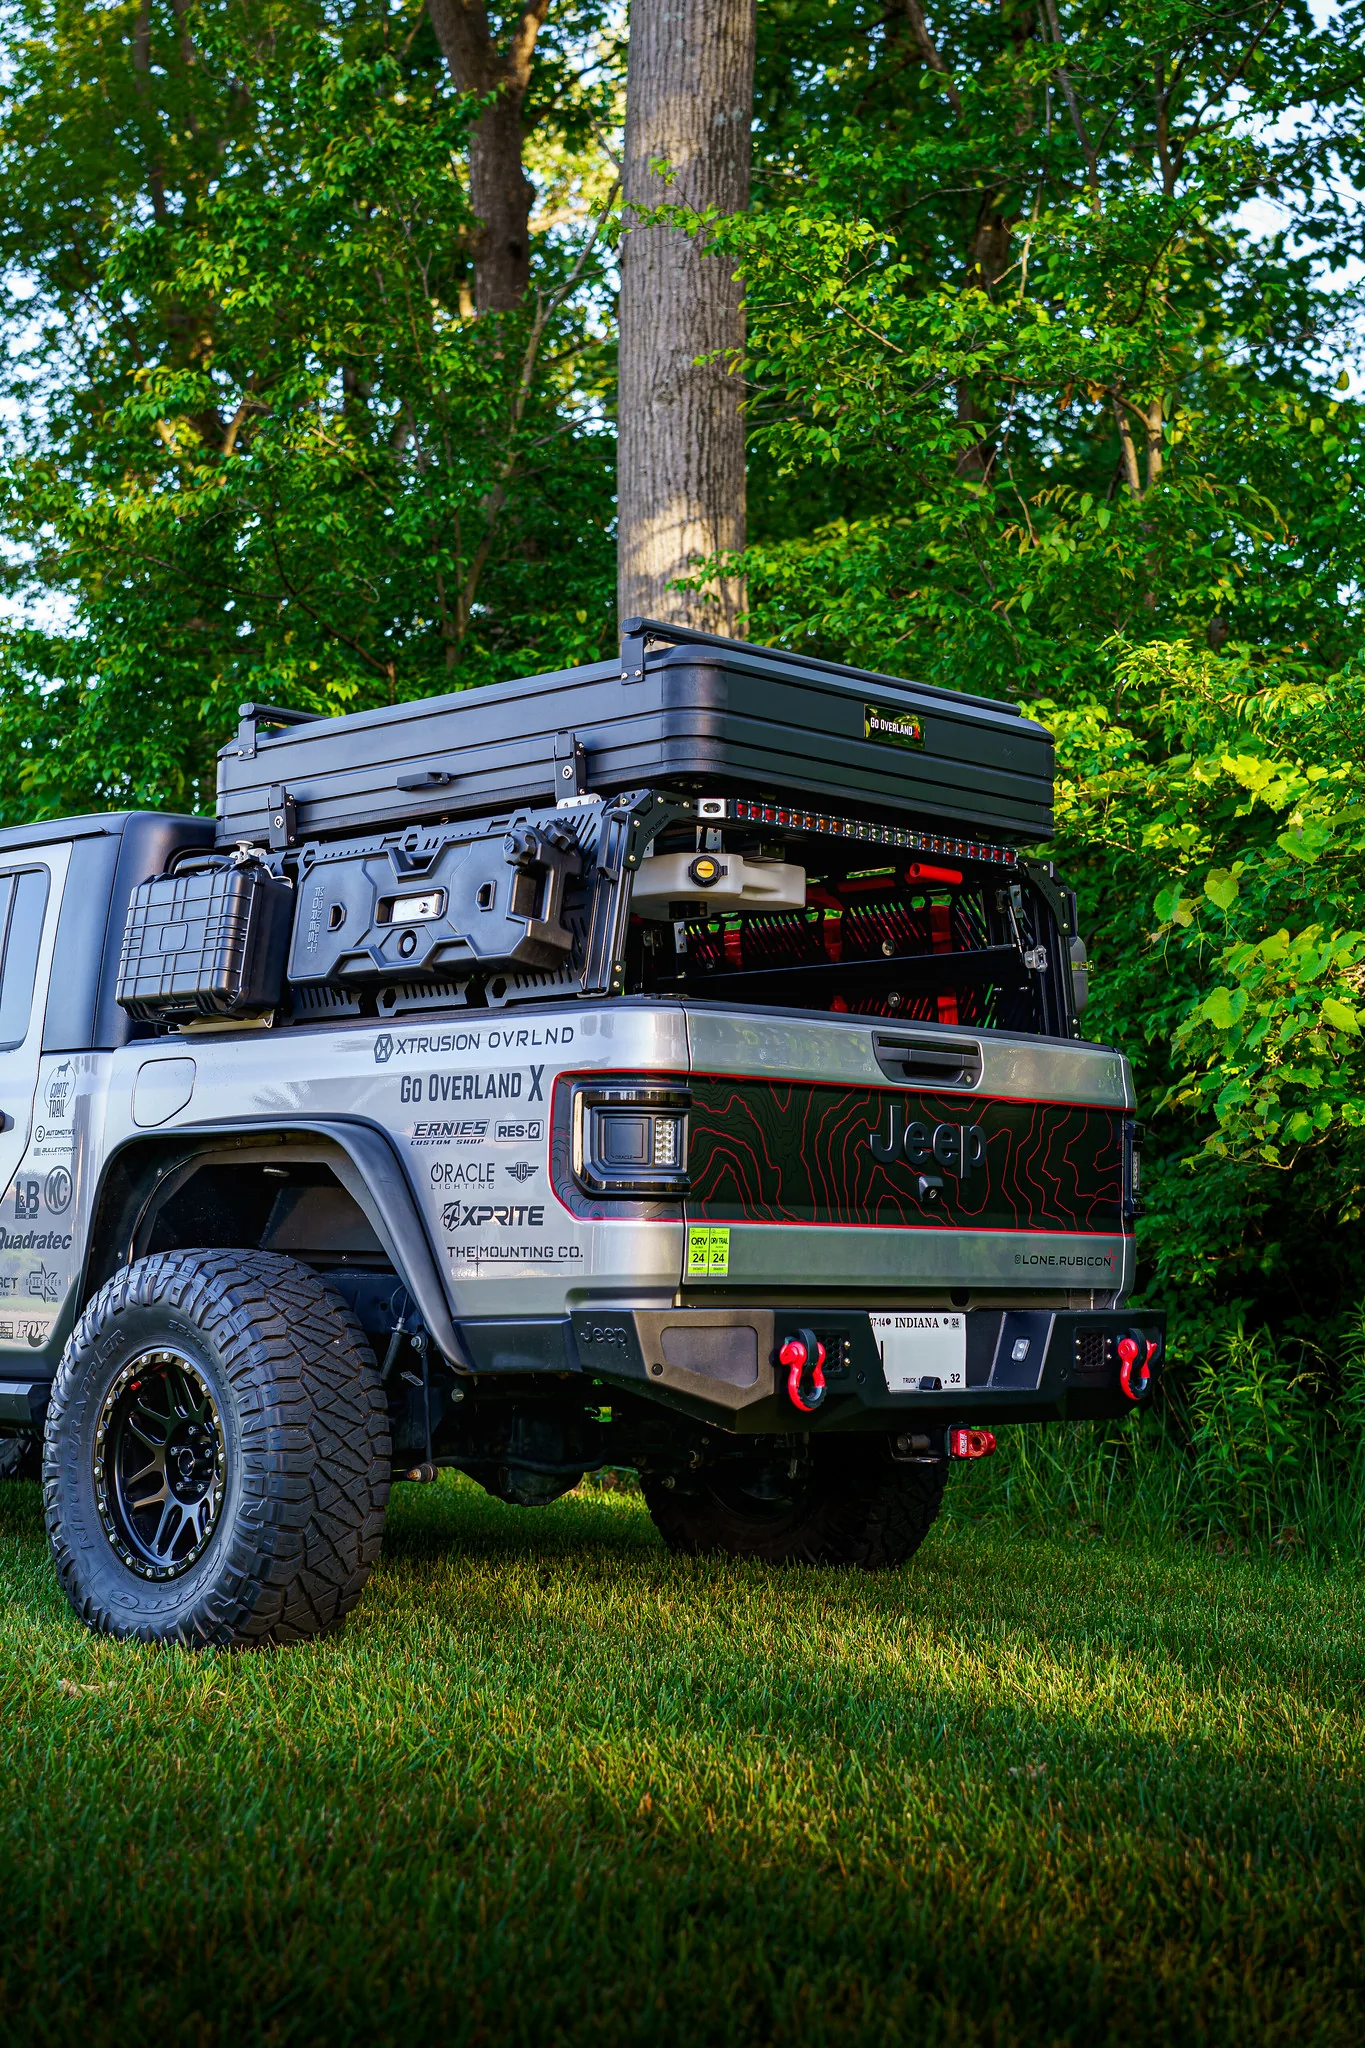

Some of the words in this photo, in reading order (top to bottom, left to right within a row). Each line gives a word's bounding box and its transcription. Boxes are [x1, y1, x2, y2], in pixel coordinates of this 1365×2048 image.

[870, 716, 879, 729] GO
[880, 719, 913, 736] OVERLAND
[306, 887, 320, 953] FOREST
[396, 1033, 480, 1055] XTRUSION
[488, 1026, 574, 1049] OVRLND
[428, 1072, 522, 1102] OVERLAND
[527, 1064, 545, 1102] X
[413, 1120, 488, 1138] ERNIES
[869, 1104, 987, 1179] Jeep
[430, 1161, 495, 1183] ORACLE
[460, 1205, 545, 1227] XPRITE
[691, 1237, 707, 1246] ORV
[447, 1246, 476, 1258] THE
[479, 1246, 553, 1258] MOUNTING
[558, 1246, 584, 1258] CO.
[692, 1253, 705, 1263] 24
[713, 1253, 725, 1263] 24
[16, 1320, 50, 1338] FOX
[894, 1317, 940, 1328] INDIANA
[951, 1318, 960, 1326] 24
[580, 1321, 628, 1348] Jeep
[950, 1373, 961, 1384] 32
